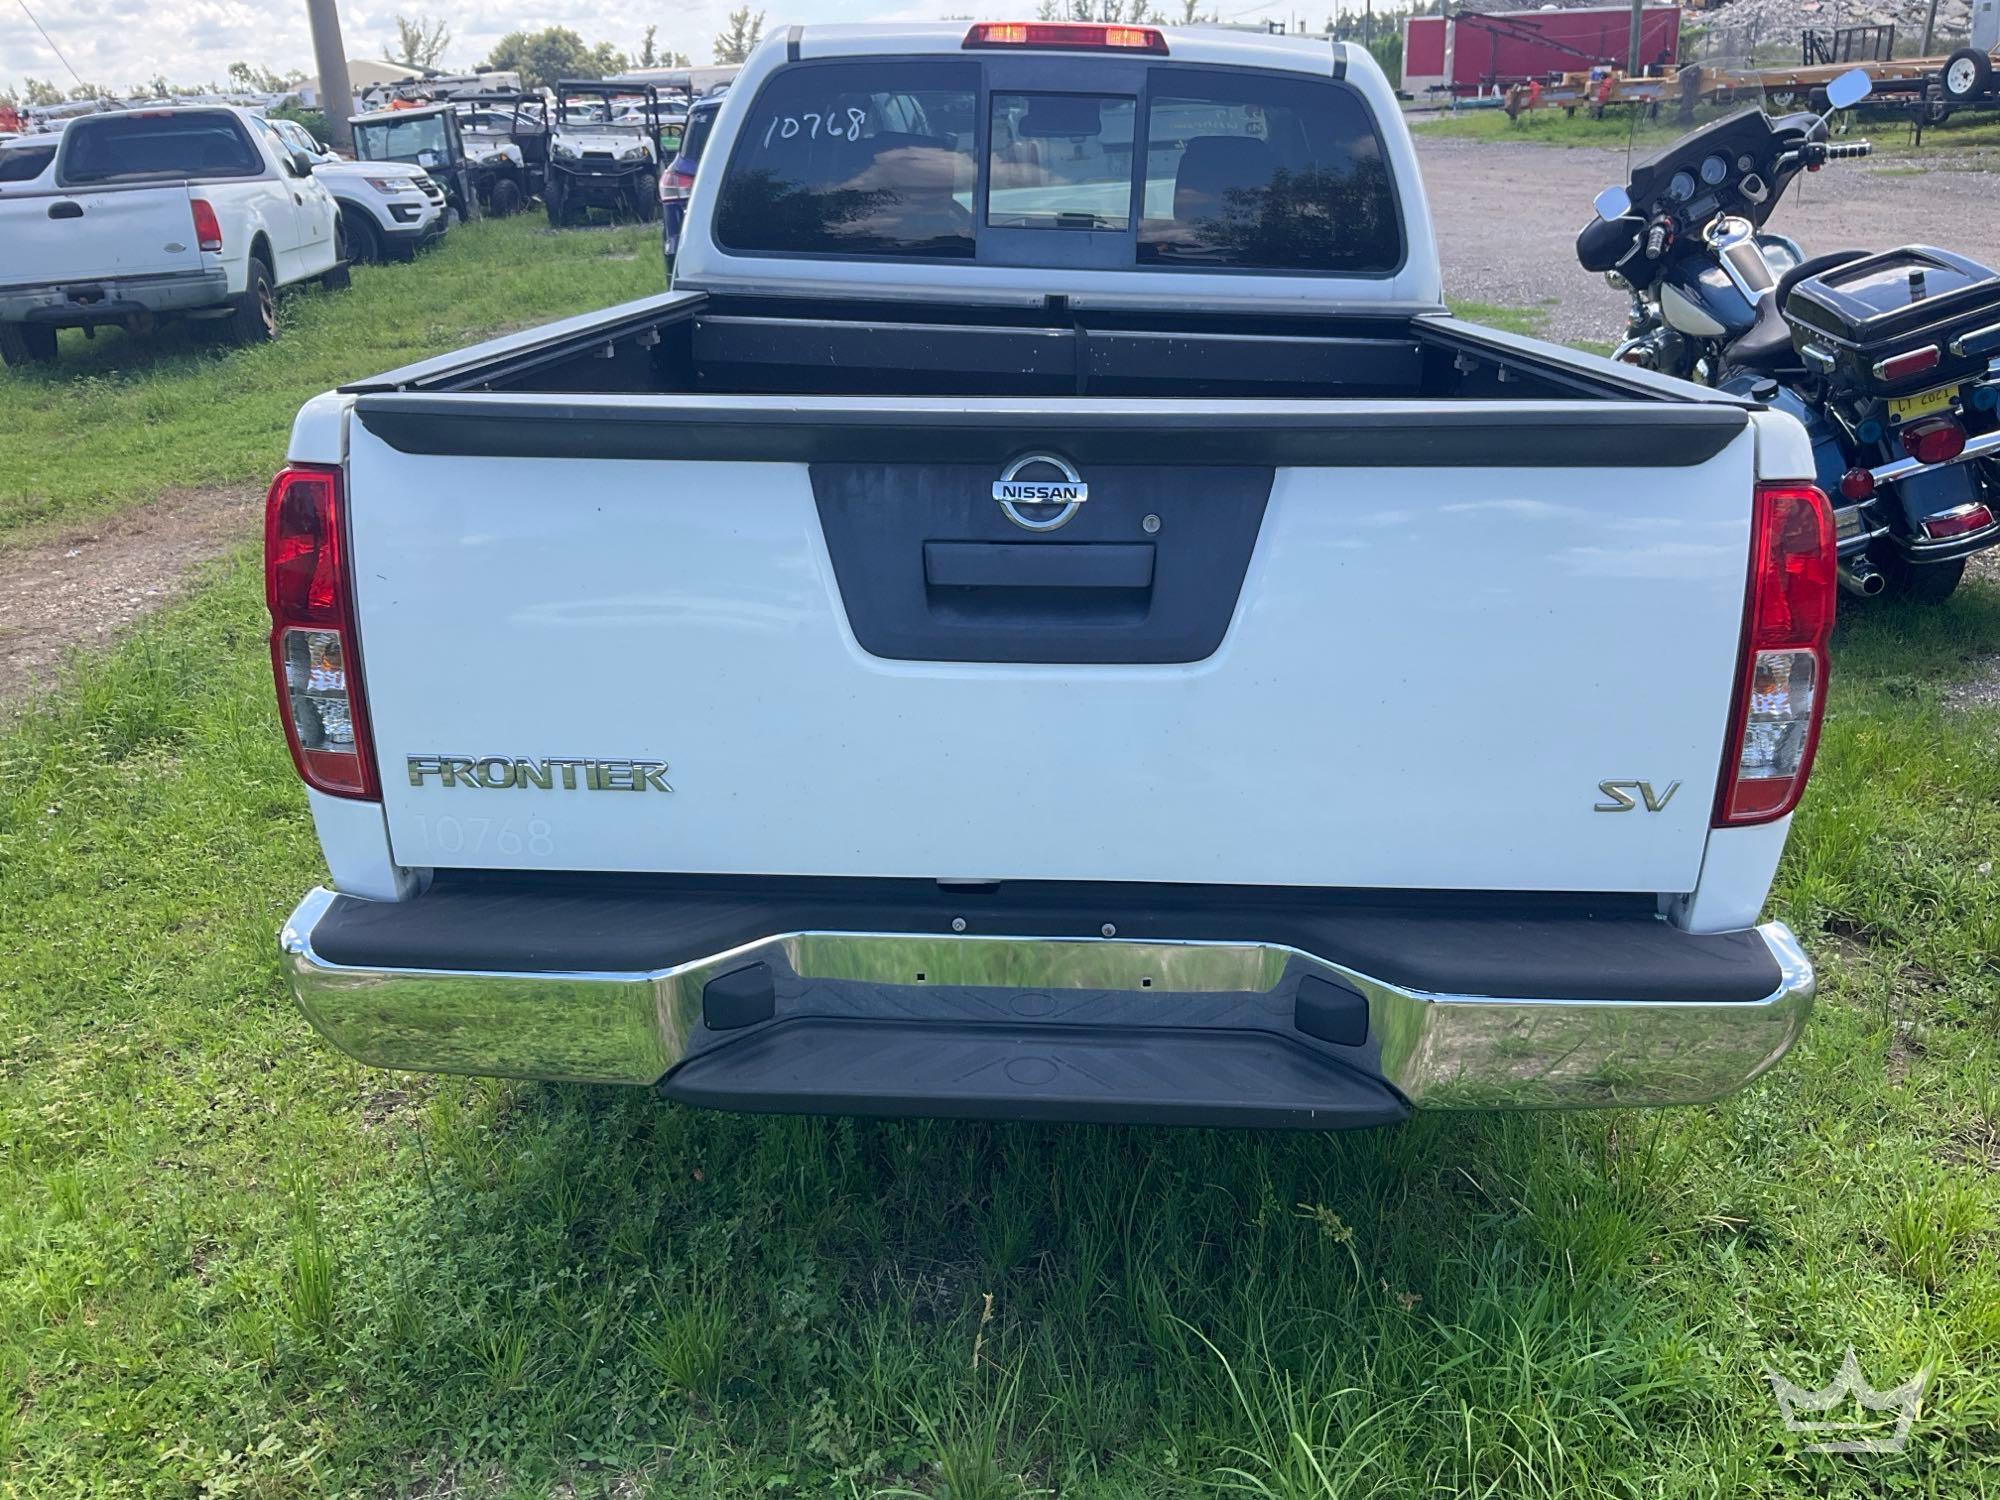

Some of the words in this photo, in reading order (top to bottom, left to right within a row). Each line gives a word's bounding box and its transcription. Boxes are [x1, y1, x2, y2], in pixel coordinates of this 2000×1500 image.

[763, 107, 866, 149] 10768
[1003, 485, 1077, 499] NISSAN
[406, 753, 674, 792] FRONTIER
[1594, 779, 1682, 812] SV
[413, 814, 555, 857] 10768
